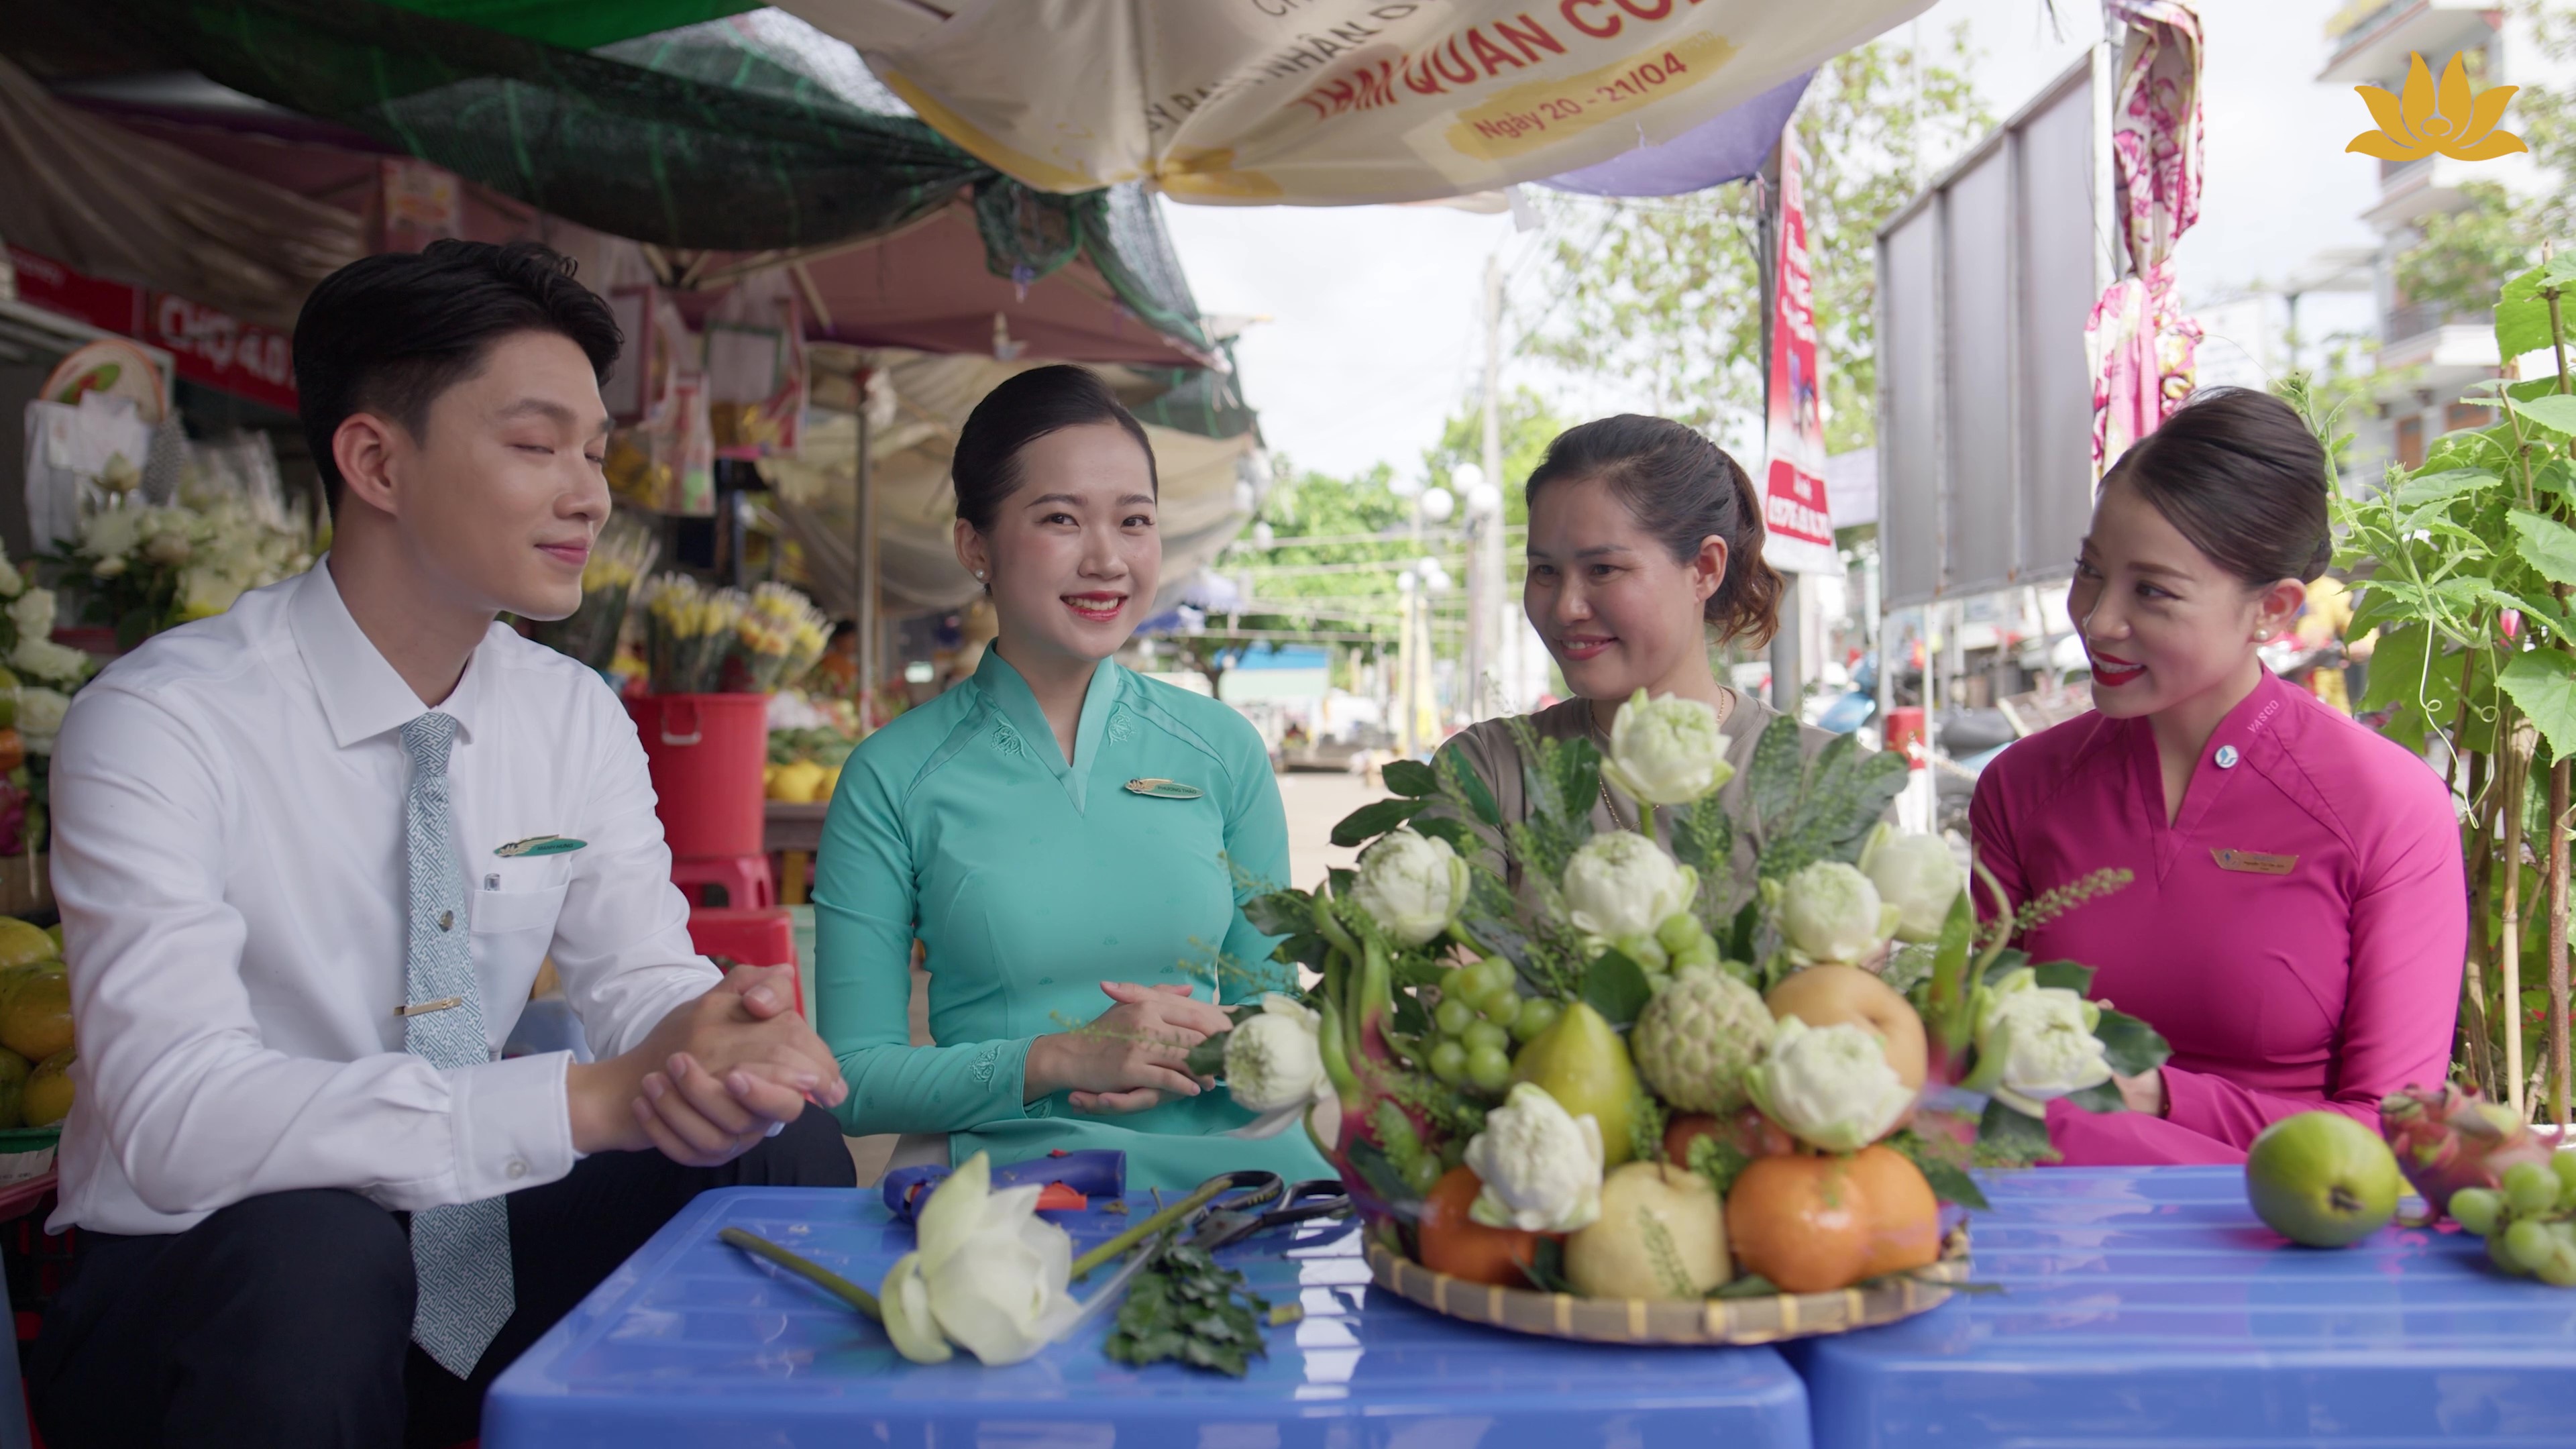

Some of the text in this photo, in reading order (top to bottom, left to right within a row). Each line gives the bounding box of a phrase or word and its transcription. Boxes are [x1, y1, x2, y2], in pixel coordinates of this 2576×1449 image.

[1402, 13, 1568, 93] QUAN
[1473, 111, 1546, 139] Ngày
[1542, 97, 1582, 121] 20
[1597, 51, 1688, 103] 21/04
[2247, 700, 2279, 733] VASCO
